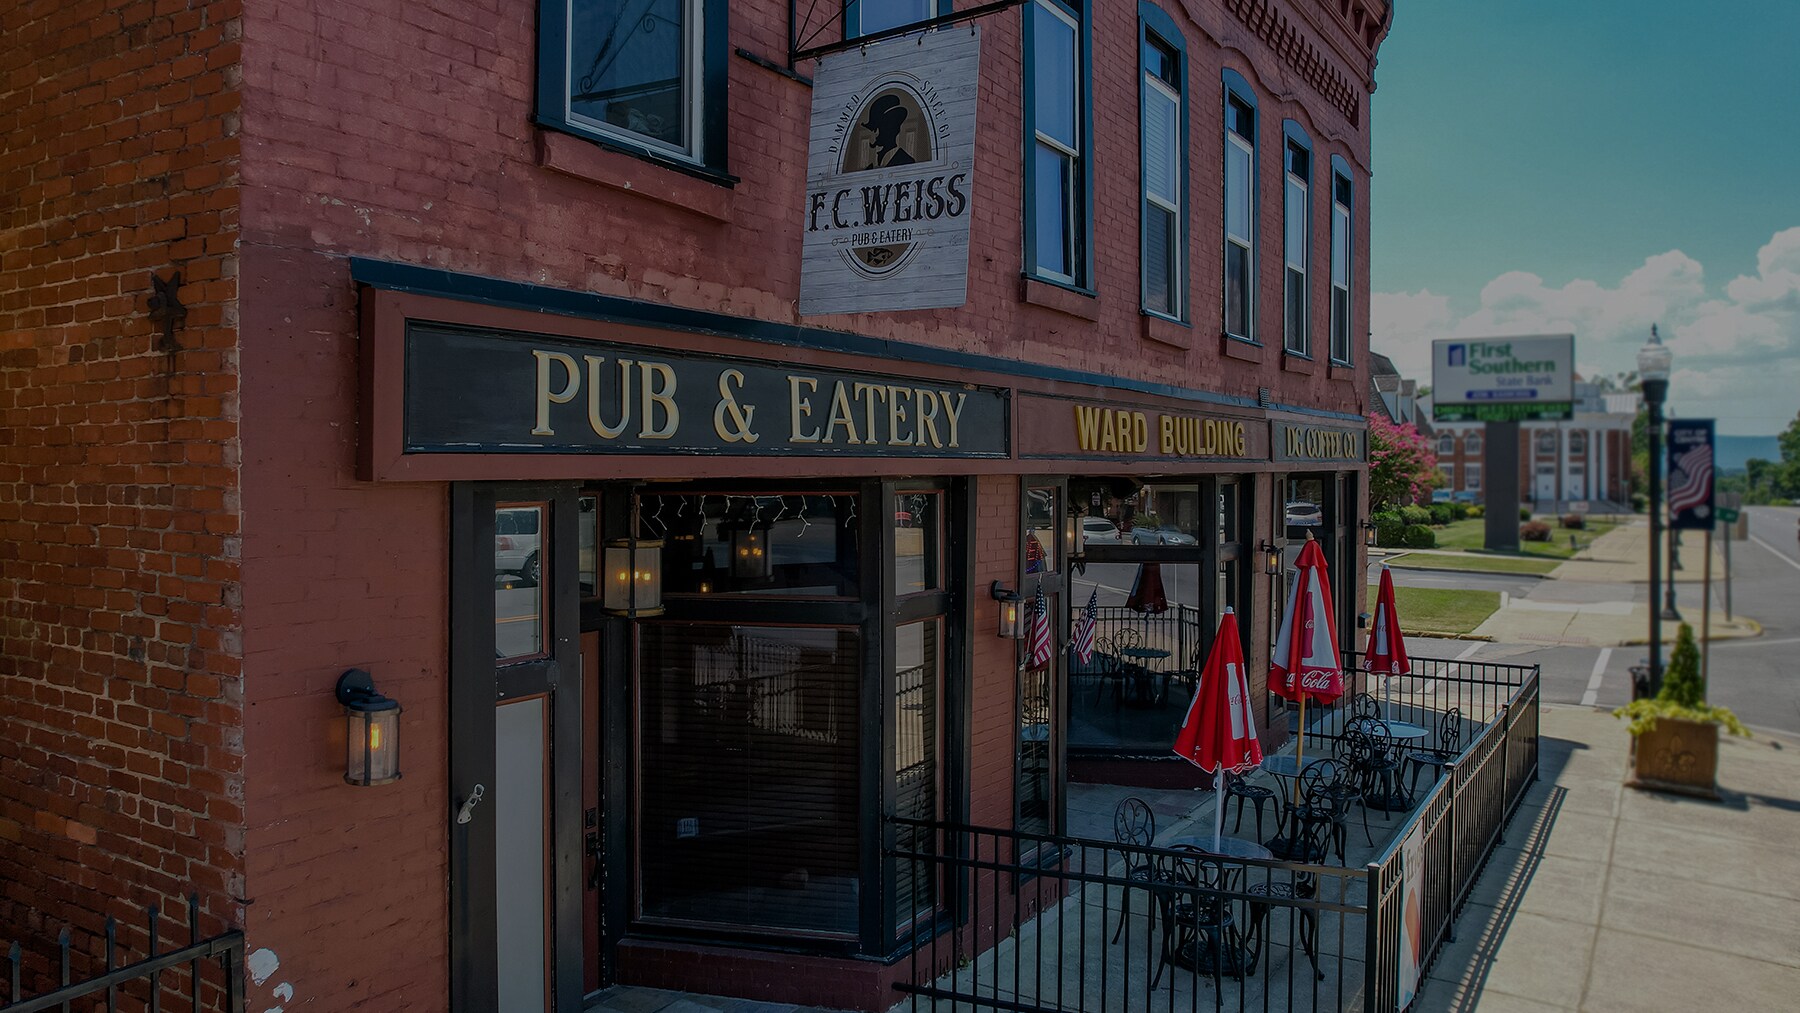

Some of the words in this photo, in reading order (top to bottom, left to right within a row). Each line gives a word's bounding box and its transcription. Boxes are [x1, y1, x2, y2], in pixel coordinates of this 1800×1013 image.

[852, 232, 870, 246] PUB
[871, 231, 878, 245] &
[880, 227, 914, 244] EATERY
[1469, 342, 1512, 358] First
[1469, 358, 1556, 375] Southern
[531, 349, 680, 440] PUB
[713, 368, 760, 443] &
[787, 375, 967, 448] EATERY
[1074, 405, 1149, 453] WARD
[1159, 414, 1247, 457] BUILDING
[1305, 428, 1342, 459] COFFEE
